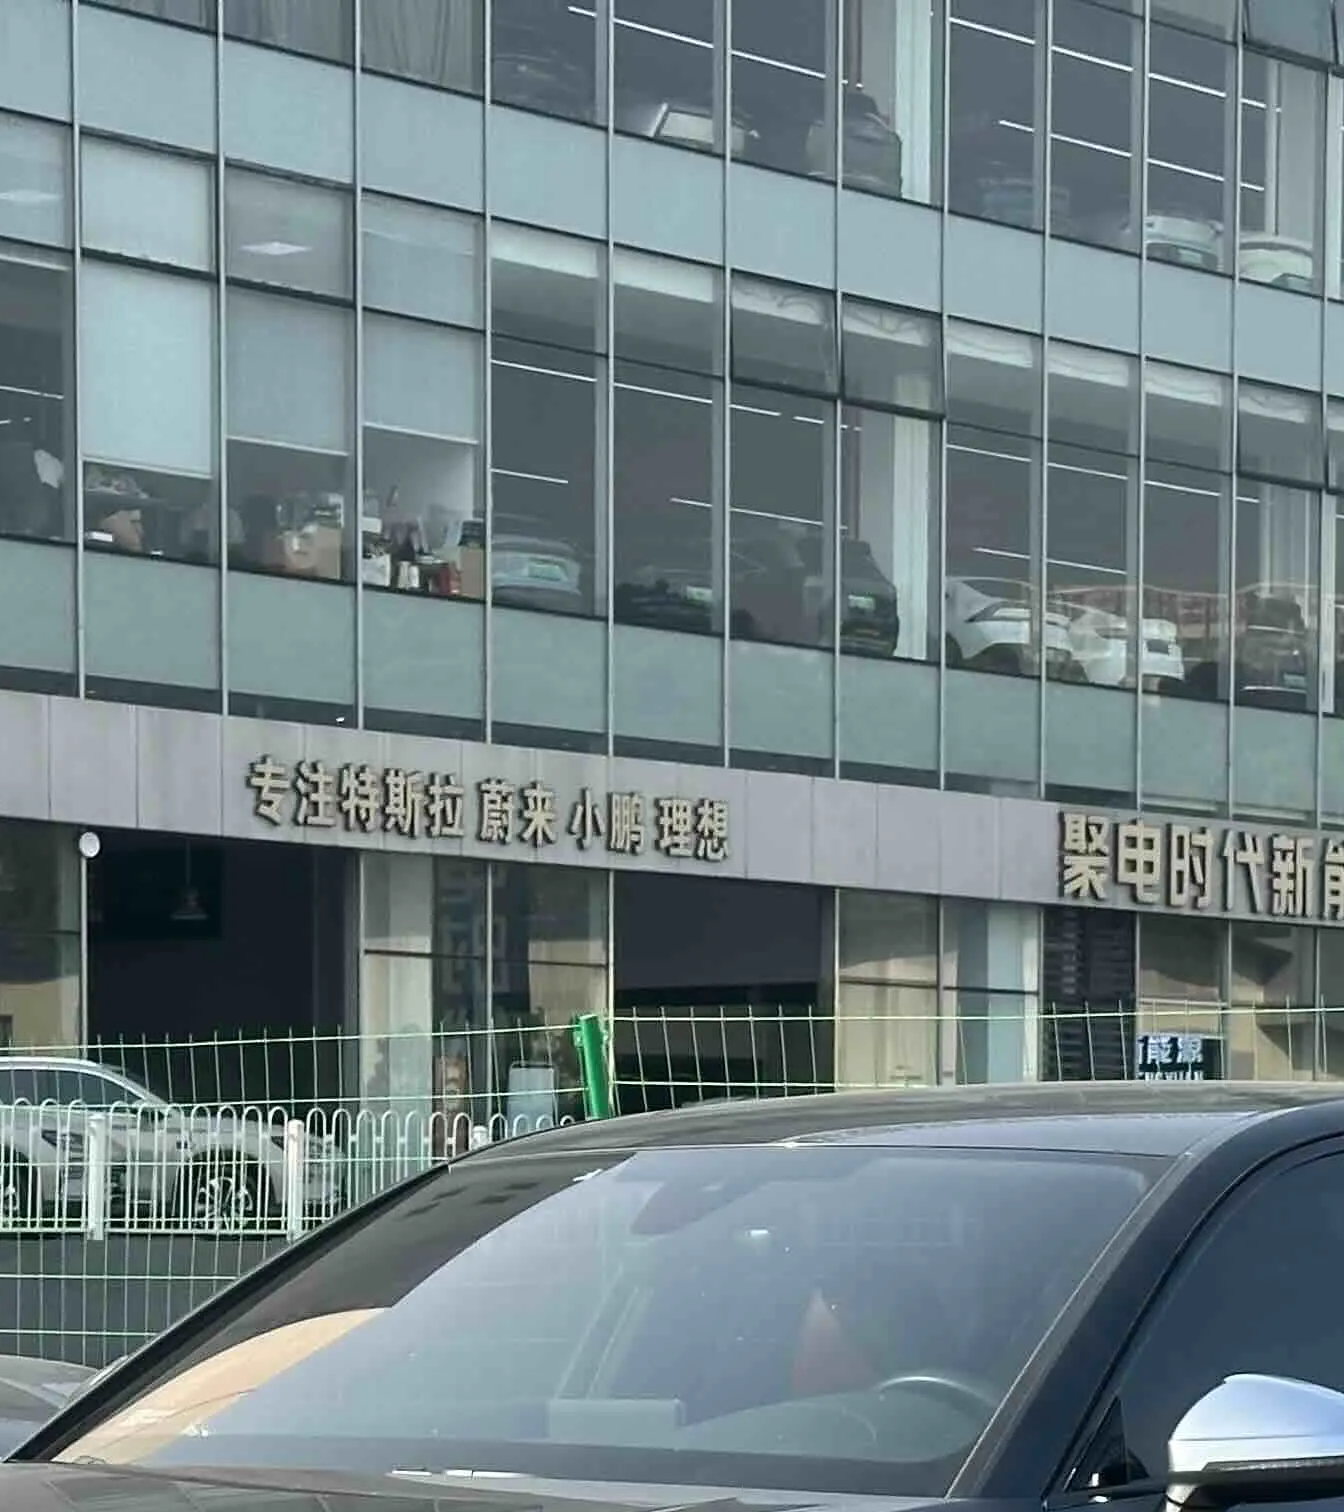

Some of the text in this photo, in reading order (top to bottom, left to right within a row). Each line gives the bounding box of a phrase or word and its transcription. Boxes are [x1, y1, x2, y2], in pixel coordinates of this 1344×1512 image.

[248, 754, 732, 861] 专注特斯拉 蔚来 小鹏 理想
